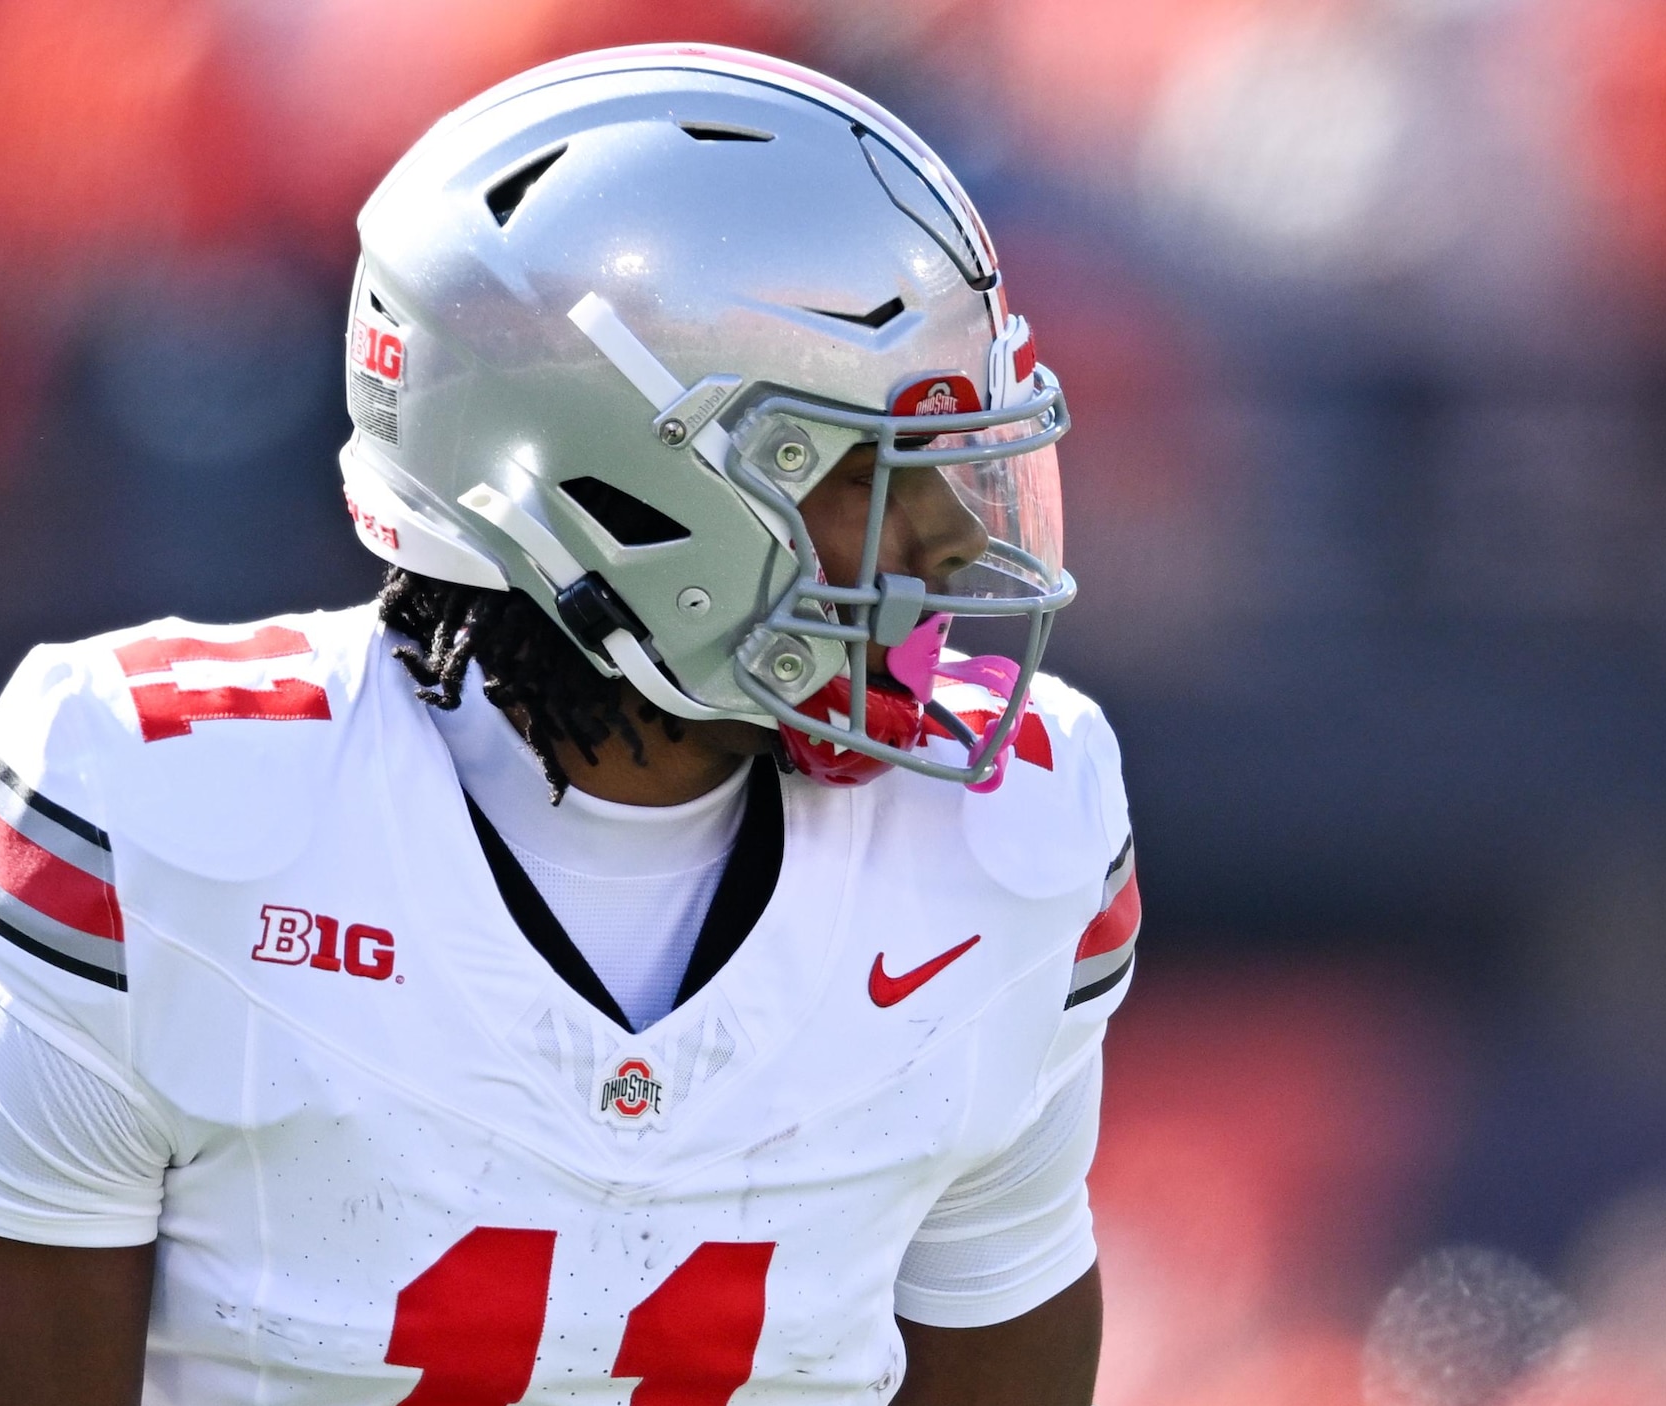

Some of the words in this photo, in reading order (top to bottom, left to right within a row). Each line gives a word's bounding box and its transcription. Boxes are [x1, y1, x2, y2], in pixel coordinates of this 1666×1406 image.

[114, 625, 333, 744] 11
[601, 1077, 629, 1112] OHIO
[627, 1073, 663, 1115] STATE
